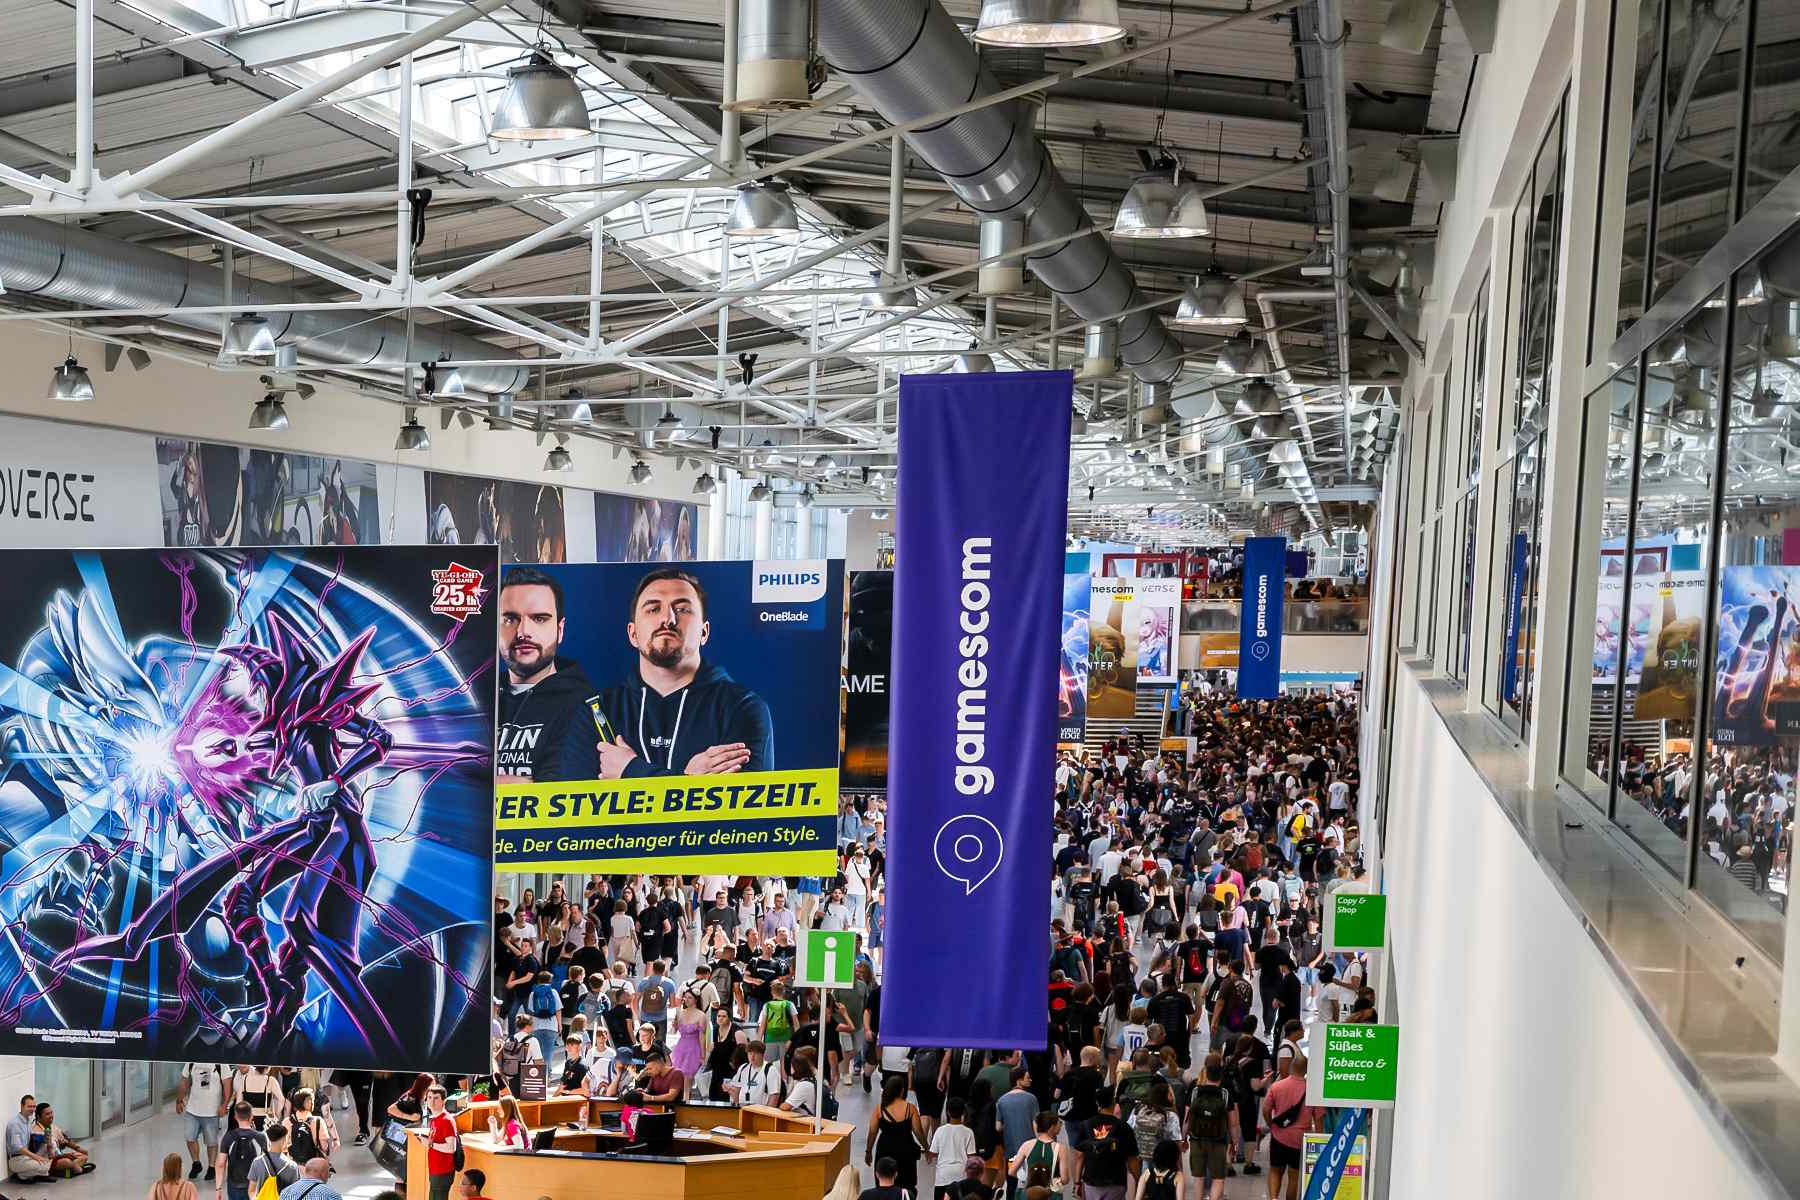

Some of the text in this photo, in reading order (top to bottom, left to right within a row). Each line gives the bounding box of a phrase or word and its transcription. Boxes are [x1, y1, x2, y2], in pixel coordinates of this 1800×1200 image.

[759, 573, 820, 586] PHILIPS
[1256, 575, 1268, 638] gamescom
[760, 611, 809, 622] OneBlade
[954, 537, 995, 795] gamescom
[1086, 661, 1113, 671] NTER
[840, 674, 886, 693] AME
[498, 727, 542, 750] LIN
[499, 751, 533, 764] ONAL
[496, 782, 821, 820] ER STYLE: BESTZEIT.
[495, 825, 820, 854] de. Der Gamechanger für deinen Style.
[1337, 896, 1358, 906] Copy
[1336, 906, 1358, 916] Shop
[1328, 1027, 1376, 1039] Tabak &
[1130, 1035, 1142, 1049] 10
[1328, 1040, 1364, 1052] Süßes
[1327, 1057, 1387, 1069] Tobacco &
[1326, 1070, 1366, 1081] Sweets
